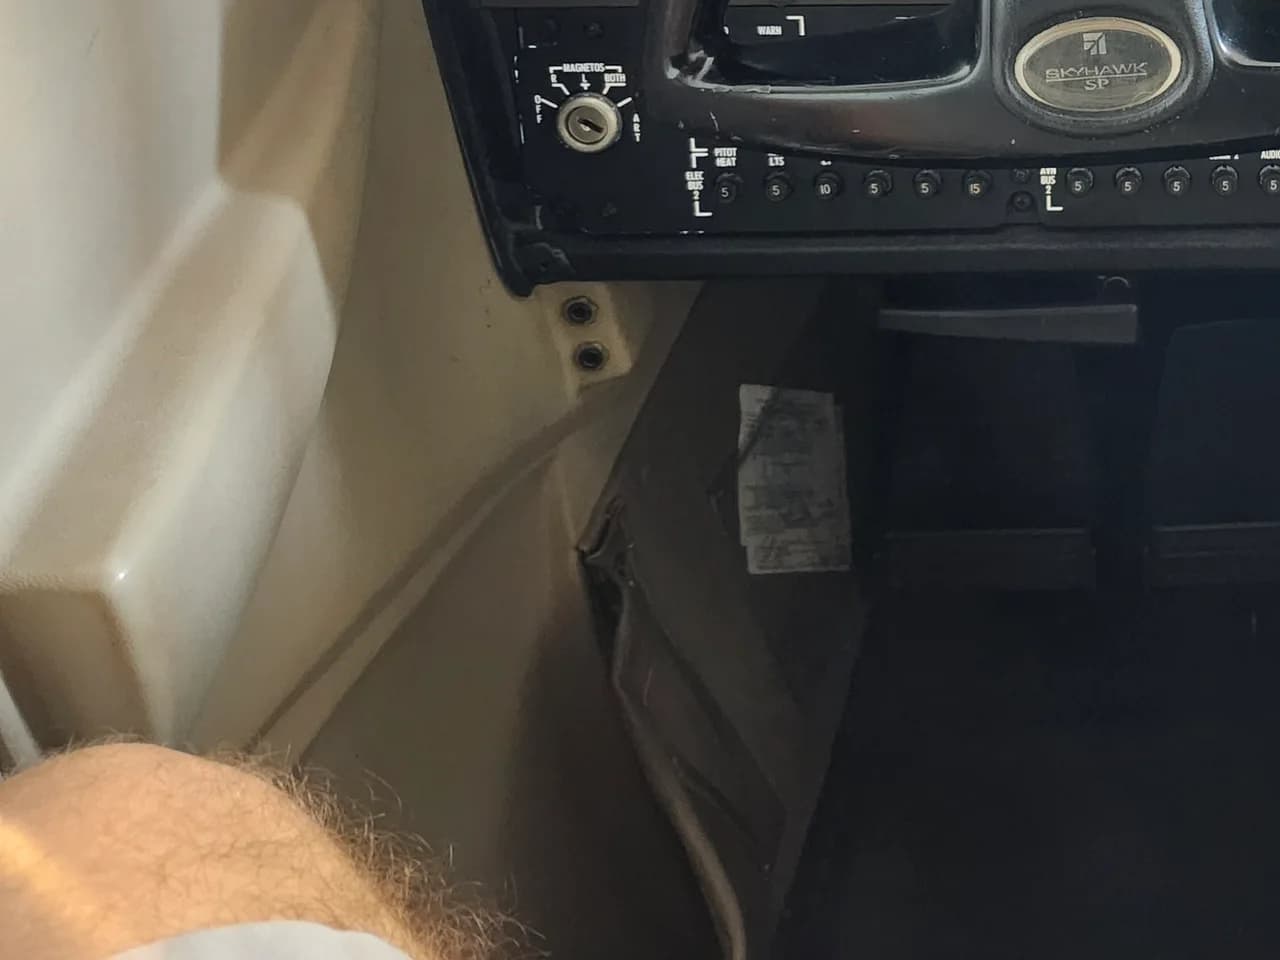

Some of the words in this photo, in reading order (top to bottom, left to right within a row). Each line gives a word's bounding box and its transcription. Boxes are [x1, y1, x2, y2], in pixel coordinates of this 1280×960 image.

[563, 62, 605, 73] MAGNETOS
[1045, 63, 1148, 82] SKYHAWK
[1084, 79, 1110, 91] SP
